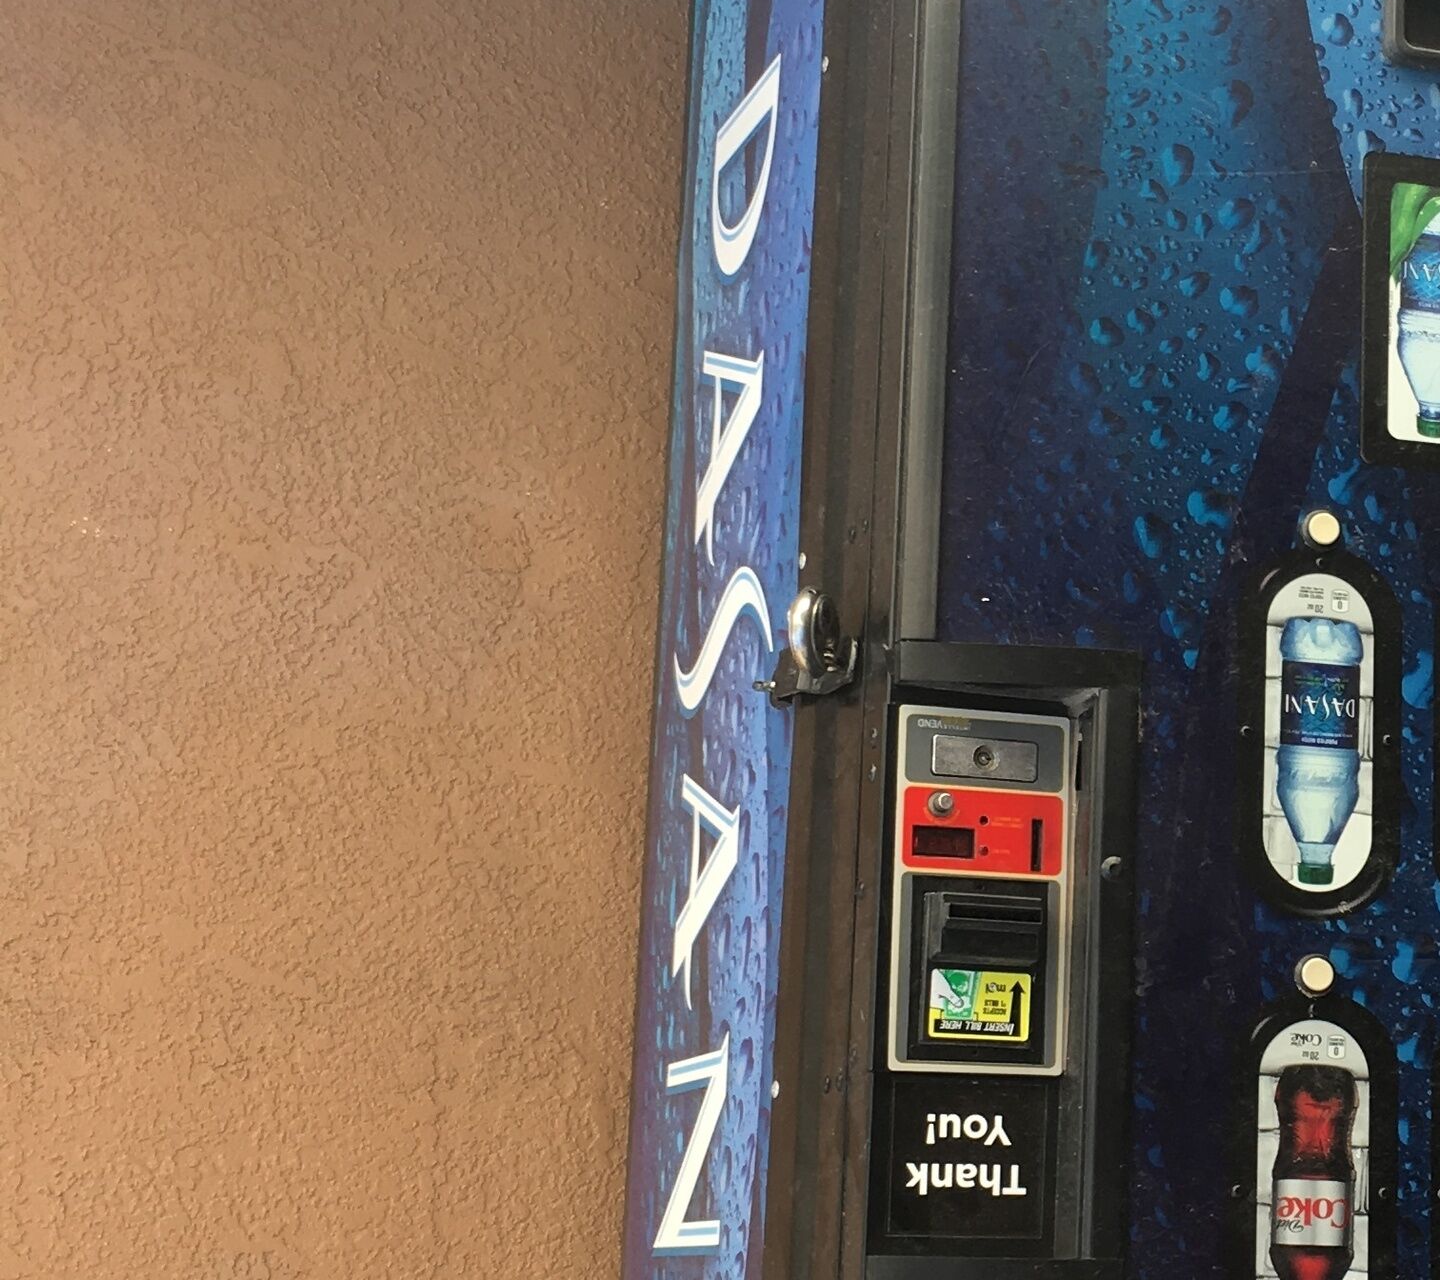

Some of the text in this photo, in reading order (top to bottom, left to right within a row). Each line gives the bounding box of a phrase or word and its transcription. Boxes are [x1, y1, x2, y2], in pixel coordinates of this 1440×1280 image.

[1315, 605, 1323, 613] 20
[1285, 694, 1355, 720] DASANI
[939, 1020, 1014, 1035] INSERT BILL HERE
[1290, 1033, 1322, 1046] Coke
[1310, 1051, 1319, 1061] 20
[926, 1113, 1012, 1146] You!
[905, 1163, 1027, 1196] Thank
[1276, 1197, 1350, 1228] Coke
